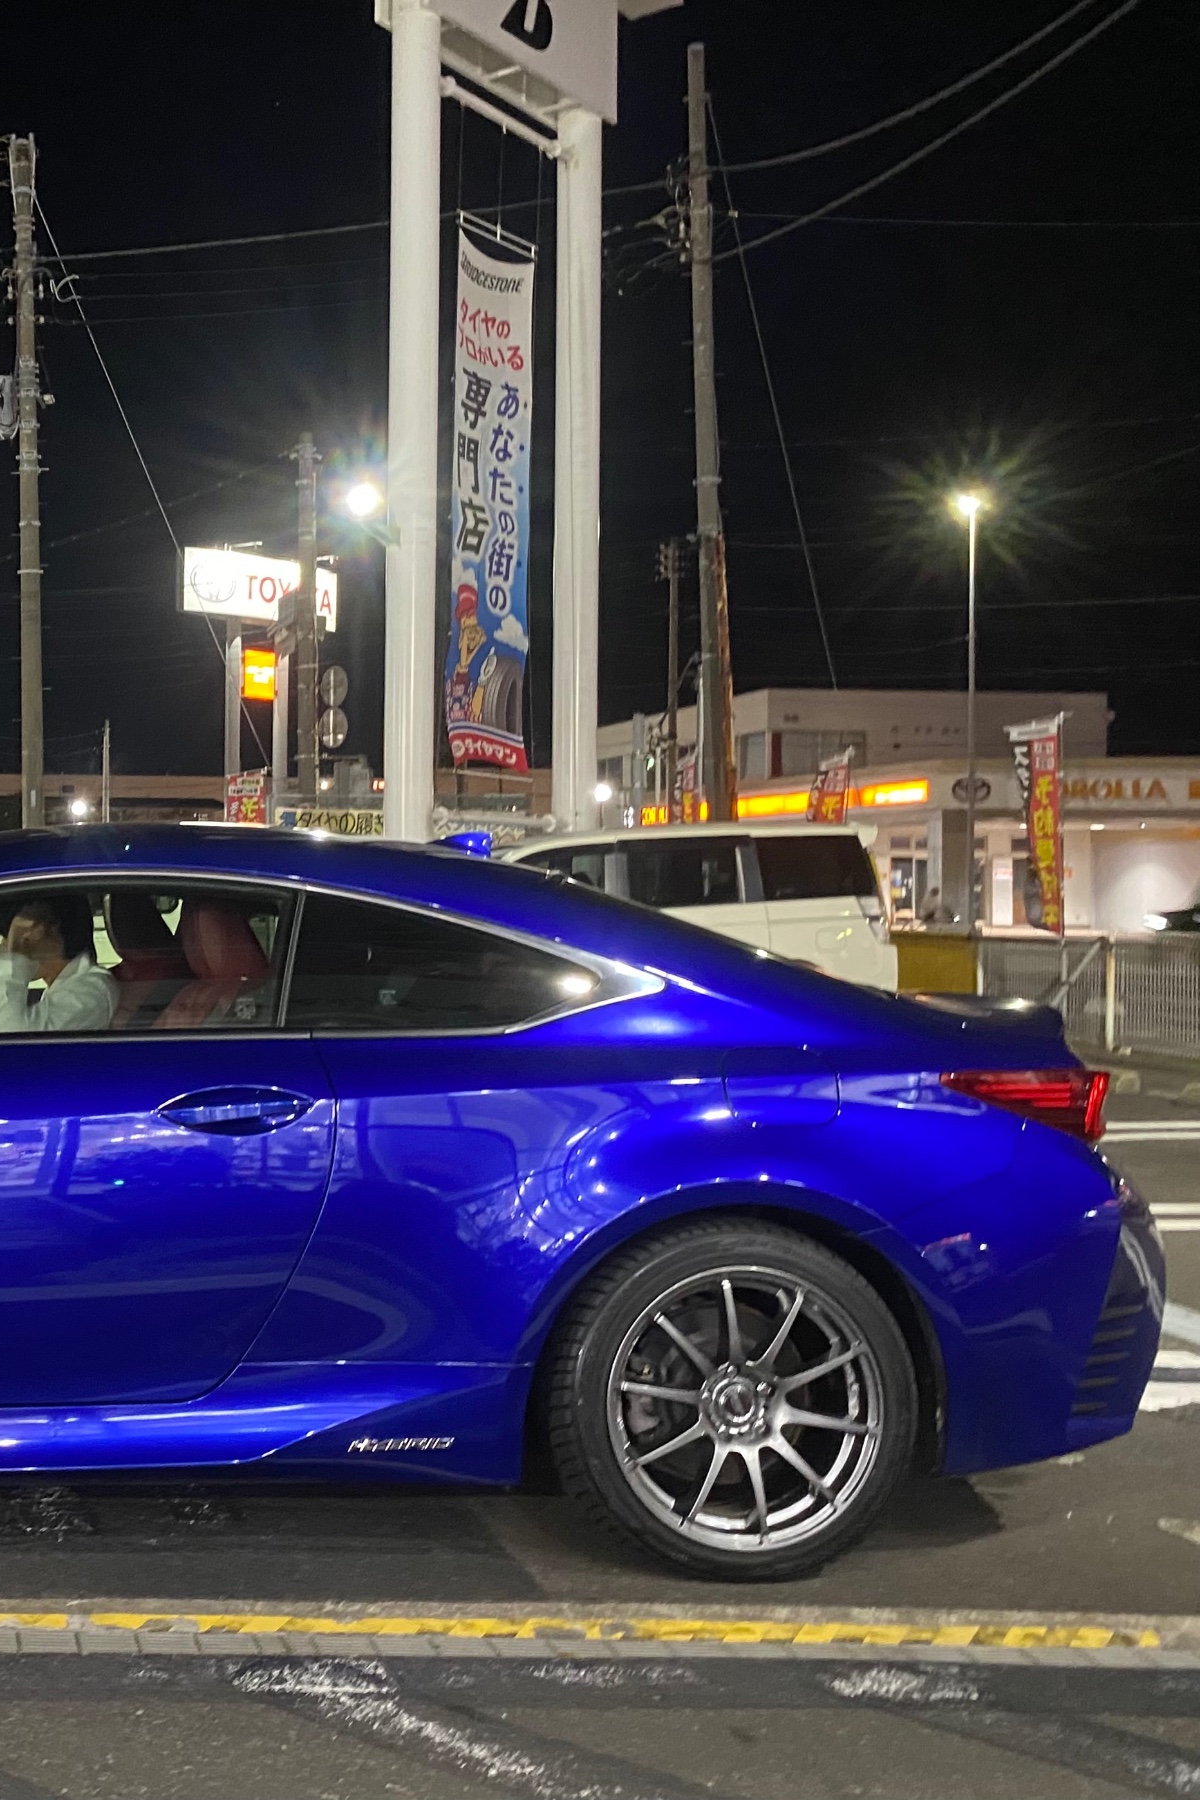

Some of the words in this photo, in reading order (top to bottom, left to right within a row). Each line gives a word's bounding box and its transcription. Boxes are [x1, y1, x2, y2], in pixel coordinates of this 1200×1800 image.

[460, 250, 525, 294] BRIDGESTONE
[460, 297, 511, 340] タイヤの
[456, 366, 492, 556] 専門店
[487, 381, 520, 611] あなたの街の
[246, 575, 332, 615] TOYA
[464, 737, 517, 765] タイヤマン
